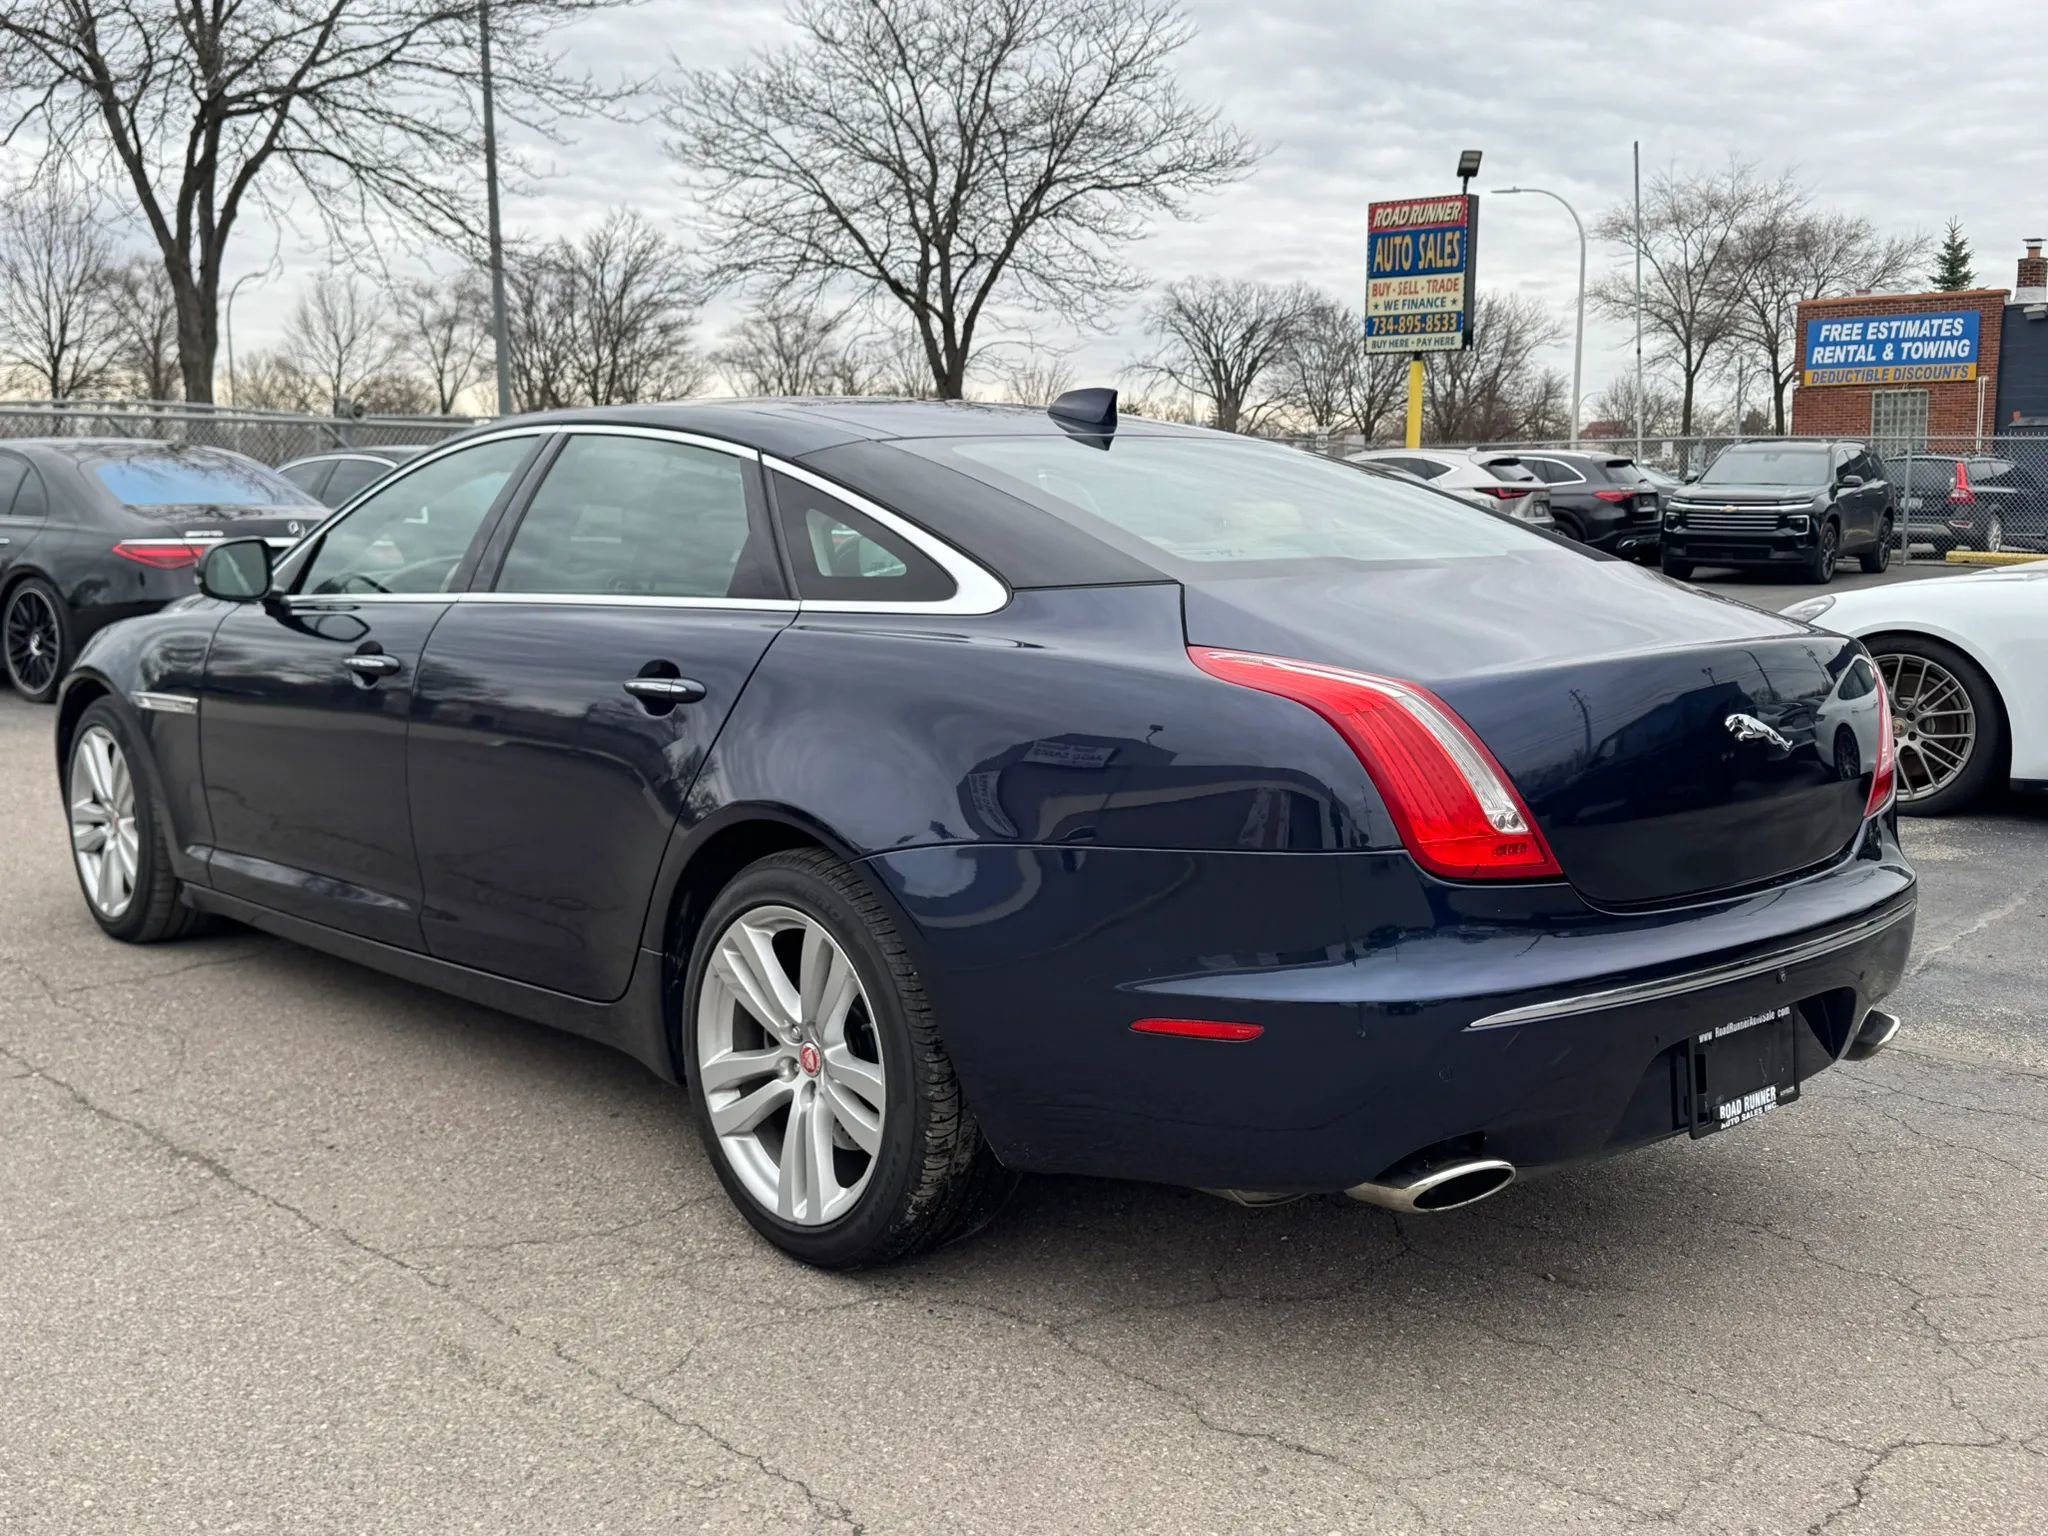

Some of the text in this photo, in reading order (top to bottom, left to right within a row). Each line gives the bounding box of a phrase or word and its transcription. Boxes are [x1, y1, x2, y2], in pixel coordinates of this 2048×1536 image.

[1373, 201, 1462, 227] ROAD RUNNER
[1373, 231, 1460, 272] AUTO SALES
[1372, 278, 1459, 297] BUY SELL TRADE
[1384, 297, 1446, 311] WE FINANCE
[1373, 313, 1457, 335] 734-895-8533
[1820, 318, 1964, 342] FREE ESTIMATES
[1372, 336, 1455, 349] BUY HERE PAY HERE
[1812, 339, 1970, 364] RENTAL & TOWING
[1812, 365, 1969, 384] DEDUCTIBLE DISCOUNTS
[1720, 1086, 1776, 1119] ROAD RUNNER
[1721, 1116, 1740, 1129] AUTO
[1741, 1107, 1763, 1120] SALES
